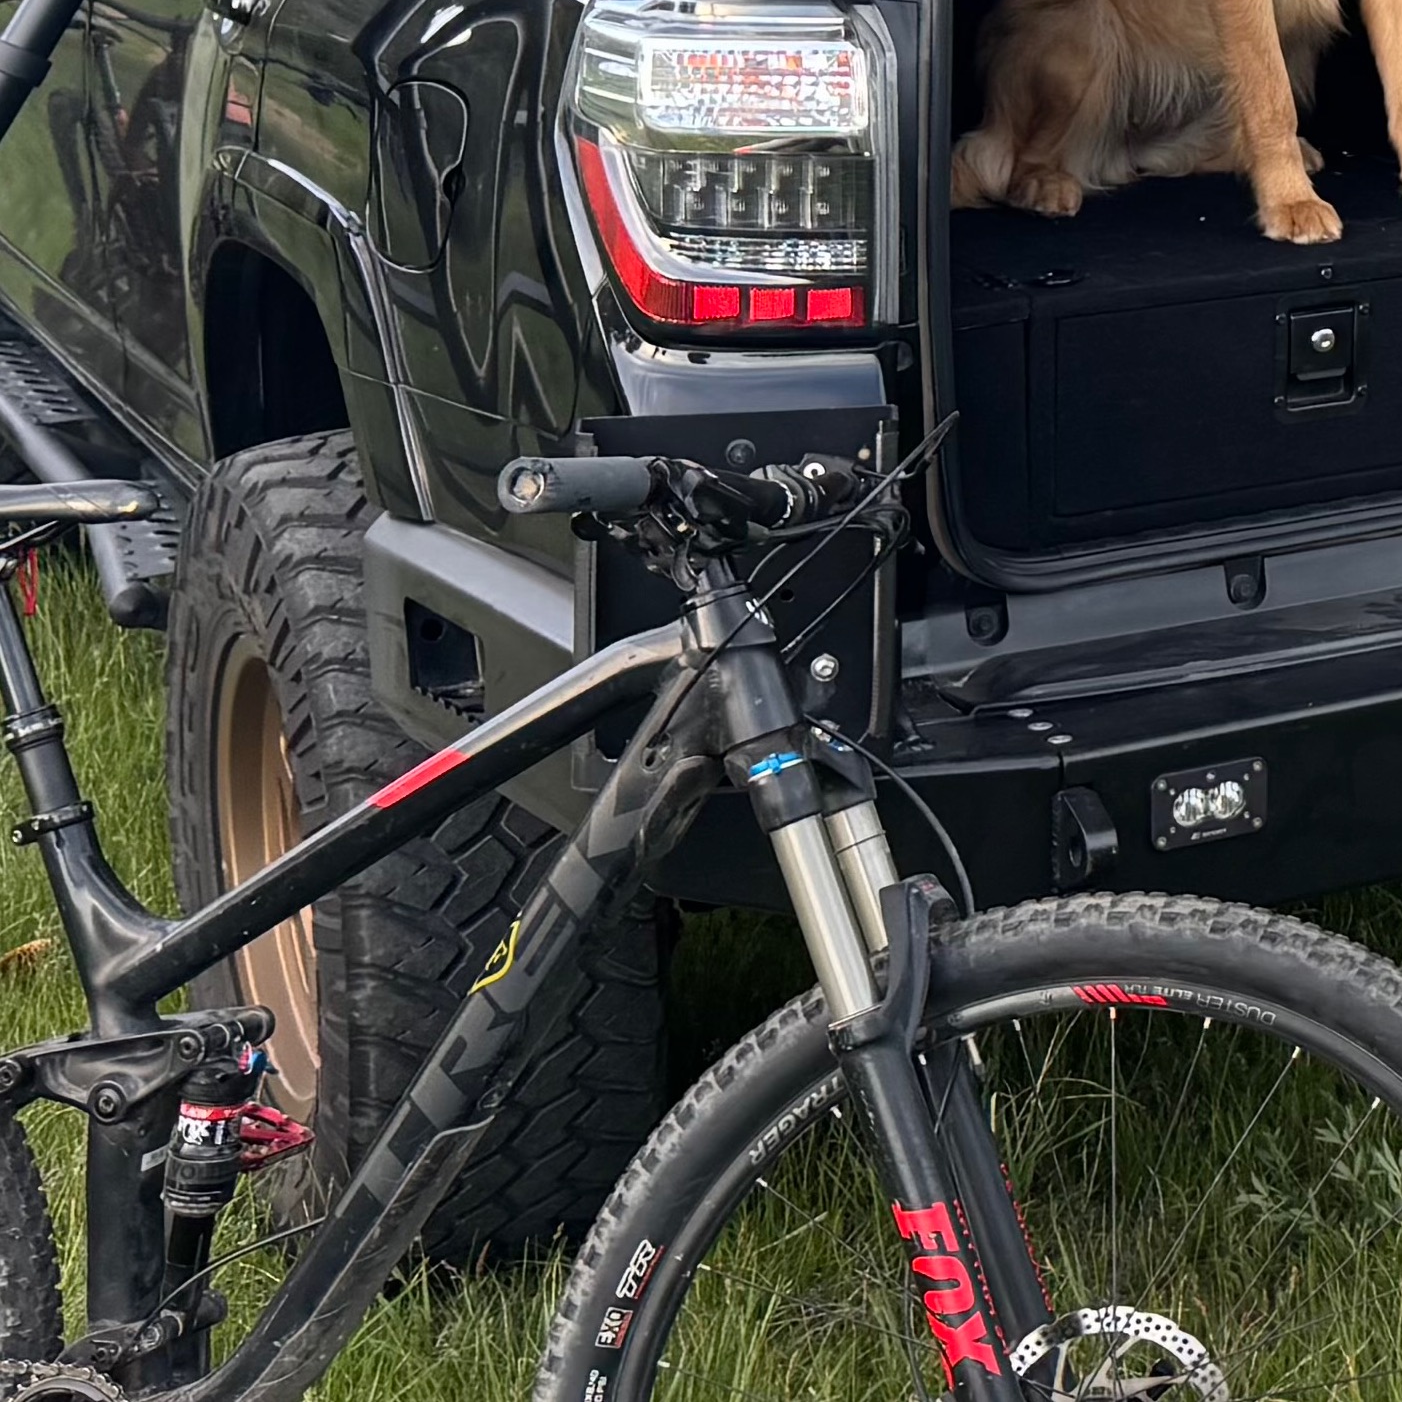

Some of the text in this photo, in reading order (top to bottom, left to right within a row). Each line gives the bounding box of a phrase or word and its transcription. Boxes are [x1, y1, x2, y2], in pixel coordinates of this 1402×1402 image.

[1195, 994, 1276, 1026] DUSTER
[615, 1239, 656, 1298] TR
[891, 1199, 1001, 1394] FOX
